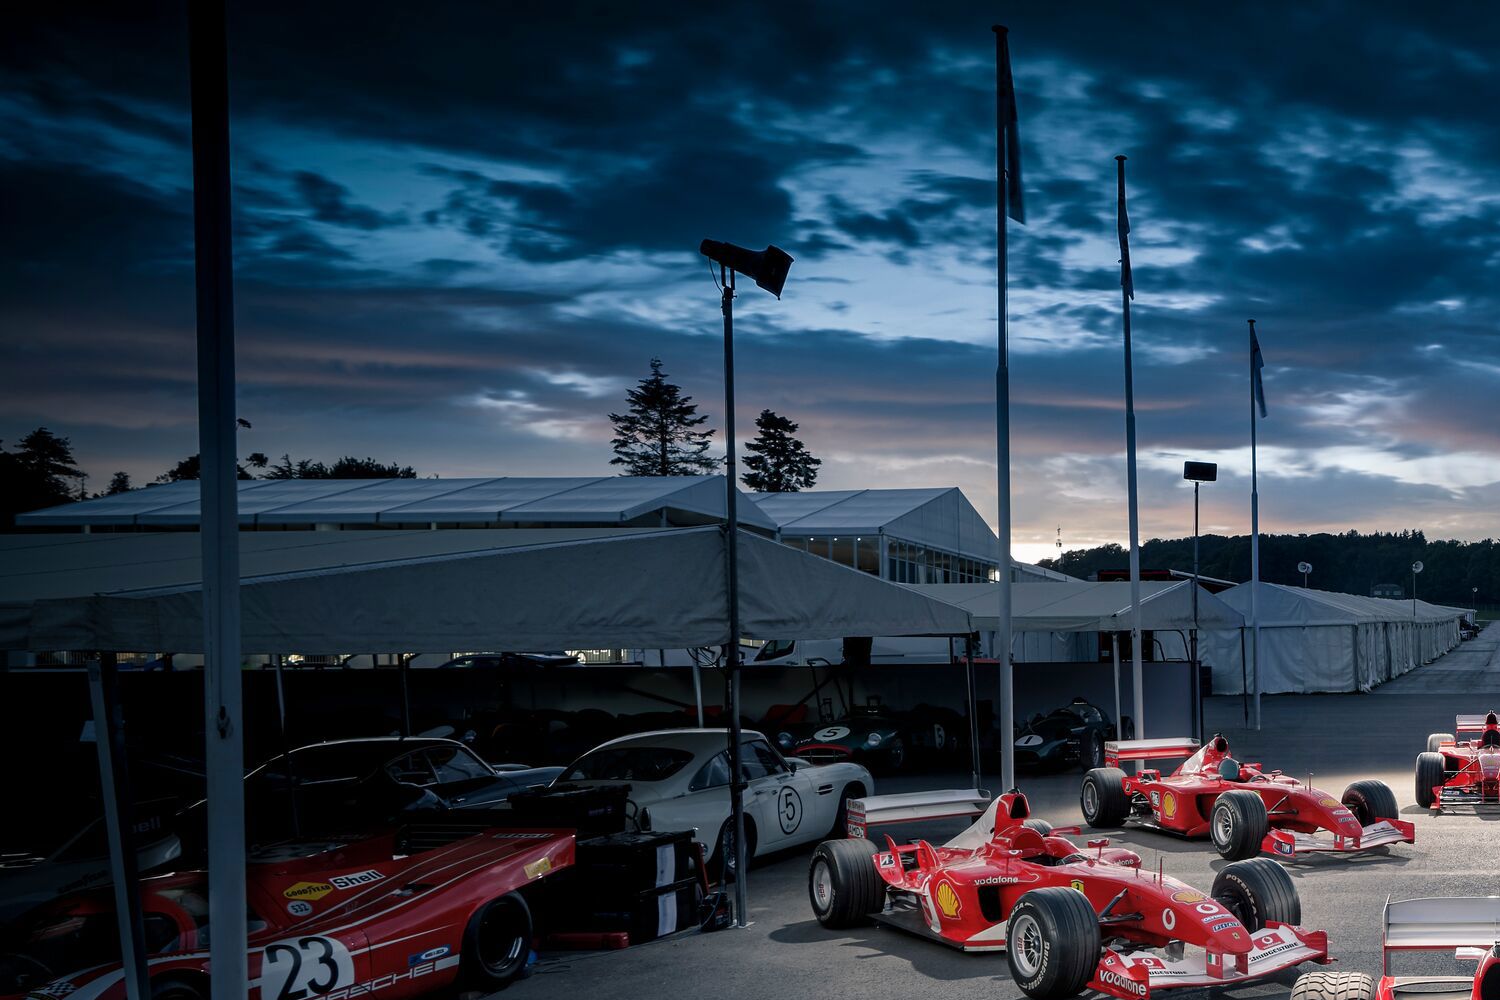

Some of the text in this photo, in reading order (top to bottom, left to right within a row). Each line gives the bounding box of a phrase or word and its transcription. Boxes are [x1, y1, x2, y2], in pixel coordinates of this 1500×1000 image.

[822, 728, 841, 738] 5
[1024, 735, 1034, 745] 1
[784, 793, 796, 821] 5
[333, 871, 383, 888] Shell
[974, 876, 1018, 885] vodafone
[286, 885, 331, 897] GOODYEAR
[1249, 942, 1299, 961] BRIDGESTONE
[1100, 970, 1147, 996] vodafone
